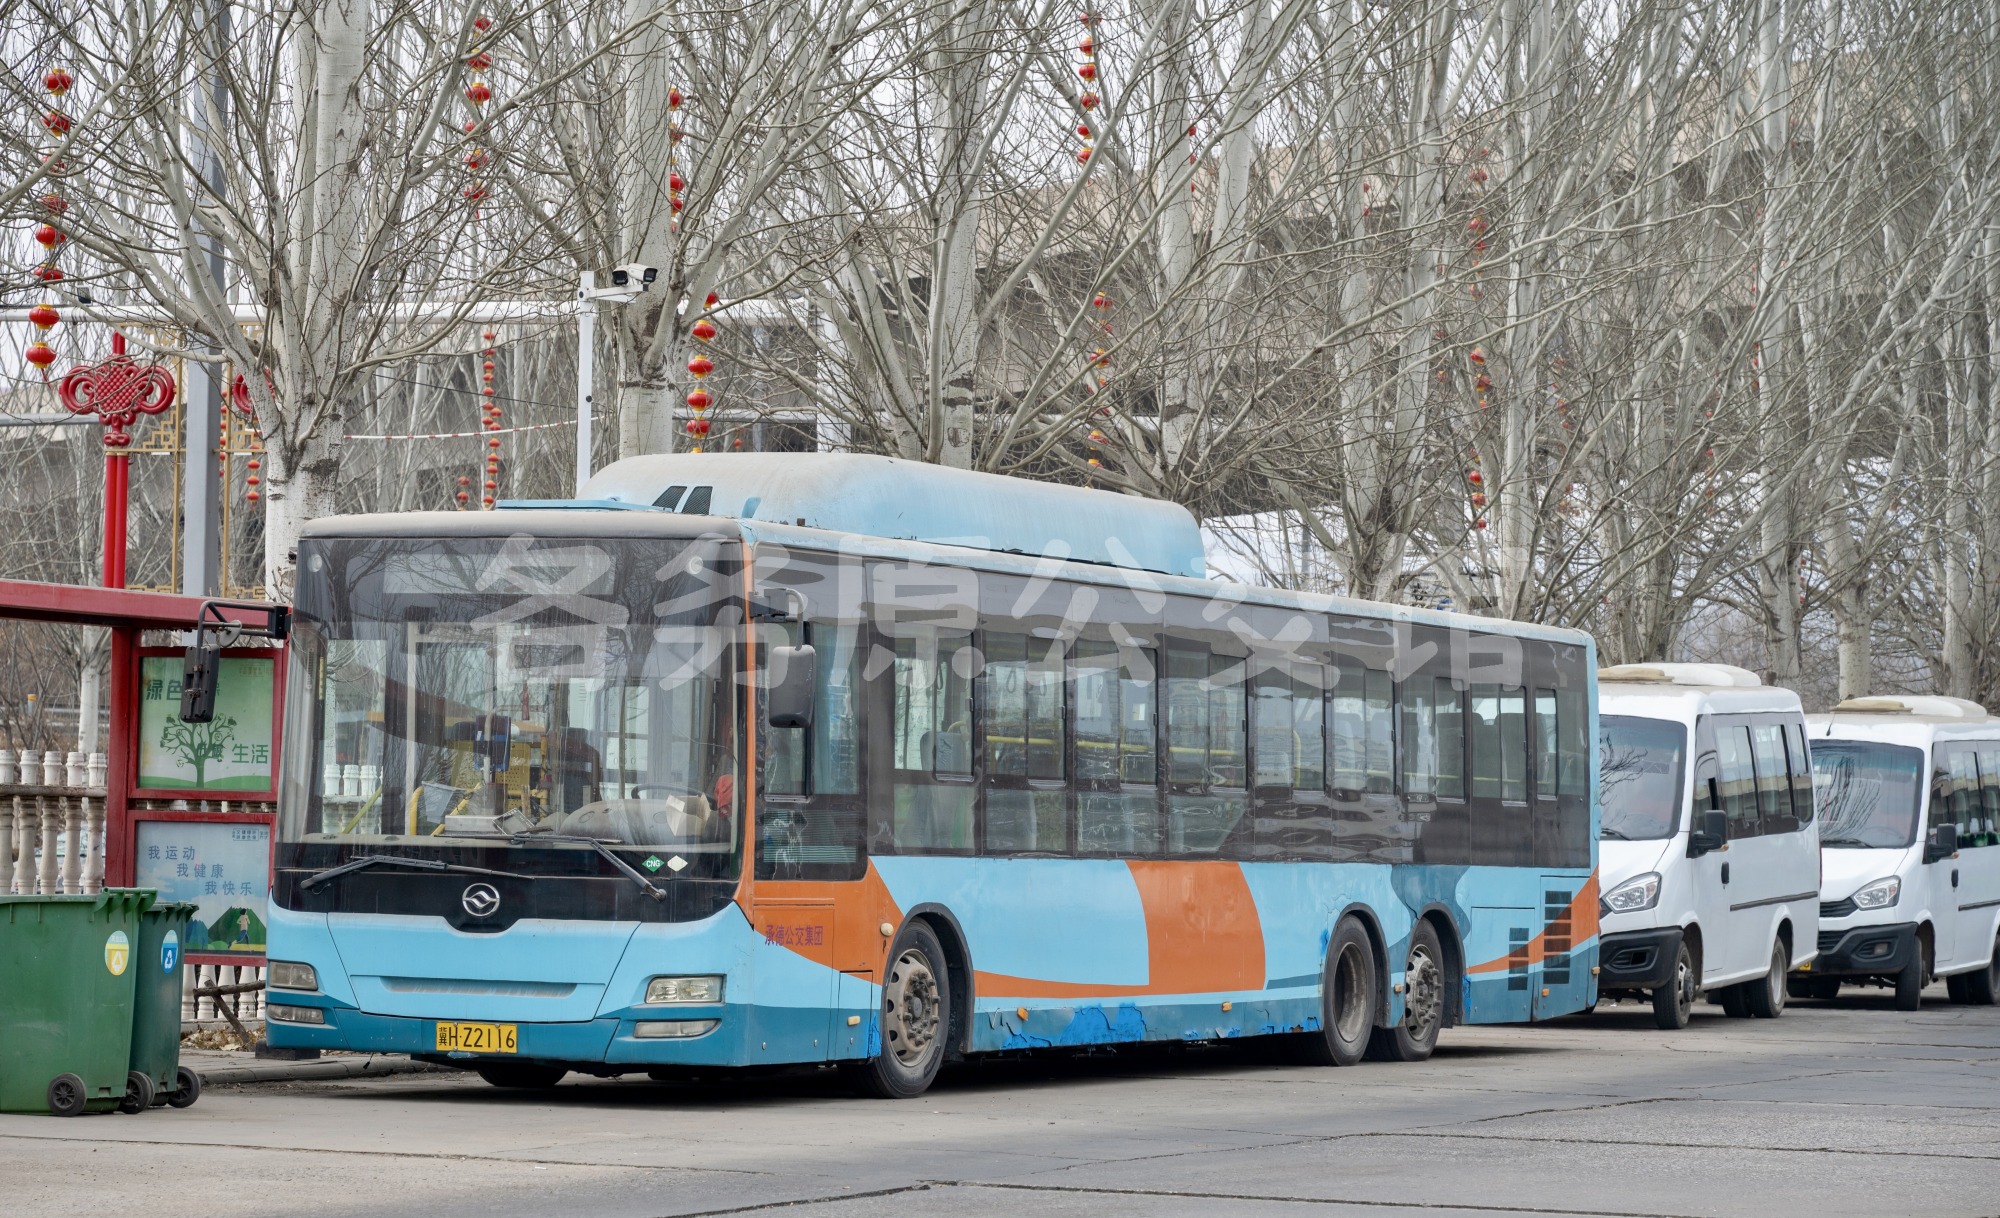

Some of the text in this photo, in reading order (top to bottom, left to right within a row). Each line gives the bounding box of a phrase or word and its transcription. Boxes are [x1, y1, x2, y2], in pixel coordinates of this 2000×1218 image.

[148, 845, 195, 860] 我运动
[177, 863, 224, 878] 我健康
[646, 859, 660, 868] CNG
[205, 880, 252, 896] 我快乐
[765, 924, 823, 946] 承德公交集团
